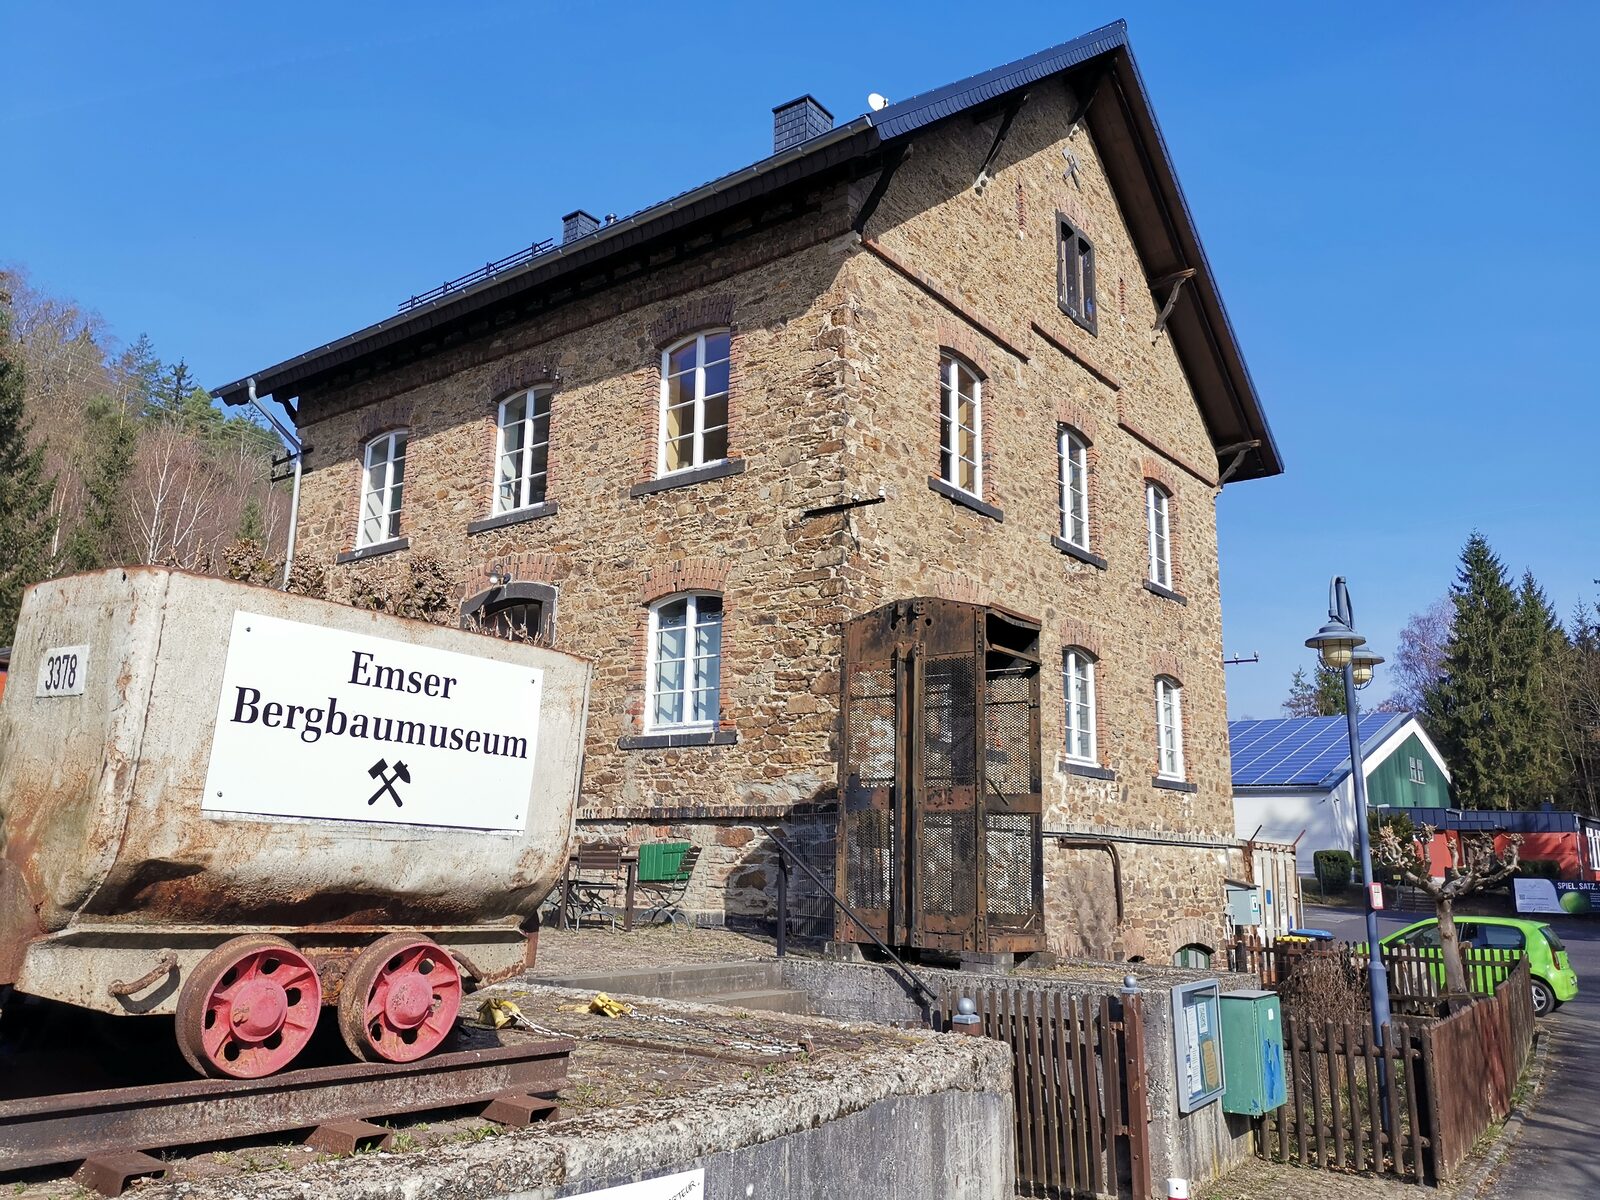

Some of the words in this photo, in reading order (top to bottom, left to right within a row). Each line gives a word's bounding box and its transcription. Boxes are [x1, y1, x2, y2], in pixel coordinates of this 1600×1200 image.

[45, 653, 78, 690] 3378
[347, 650, 457, 699] Emser
[229, 685, 528, 759] Bergbaumuseum
[1557, 882, 1578, 890] SPIEL.
[1579, 882, 1598, 890] SATZ.
